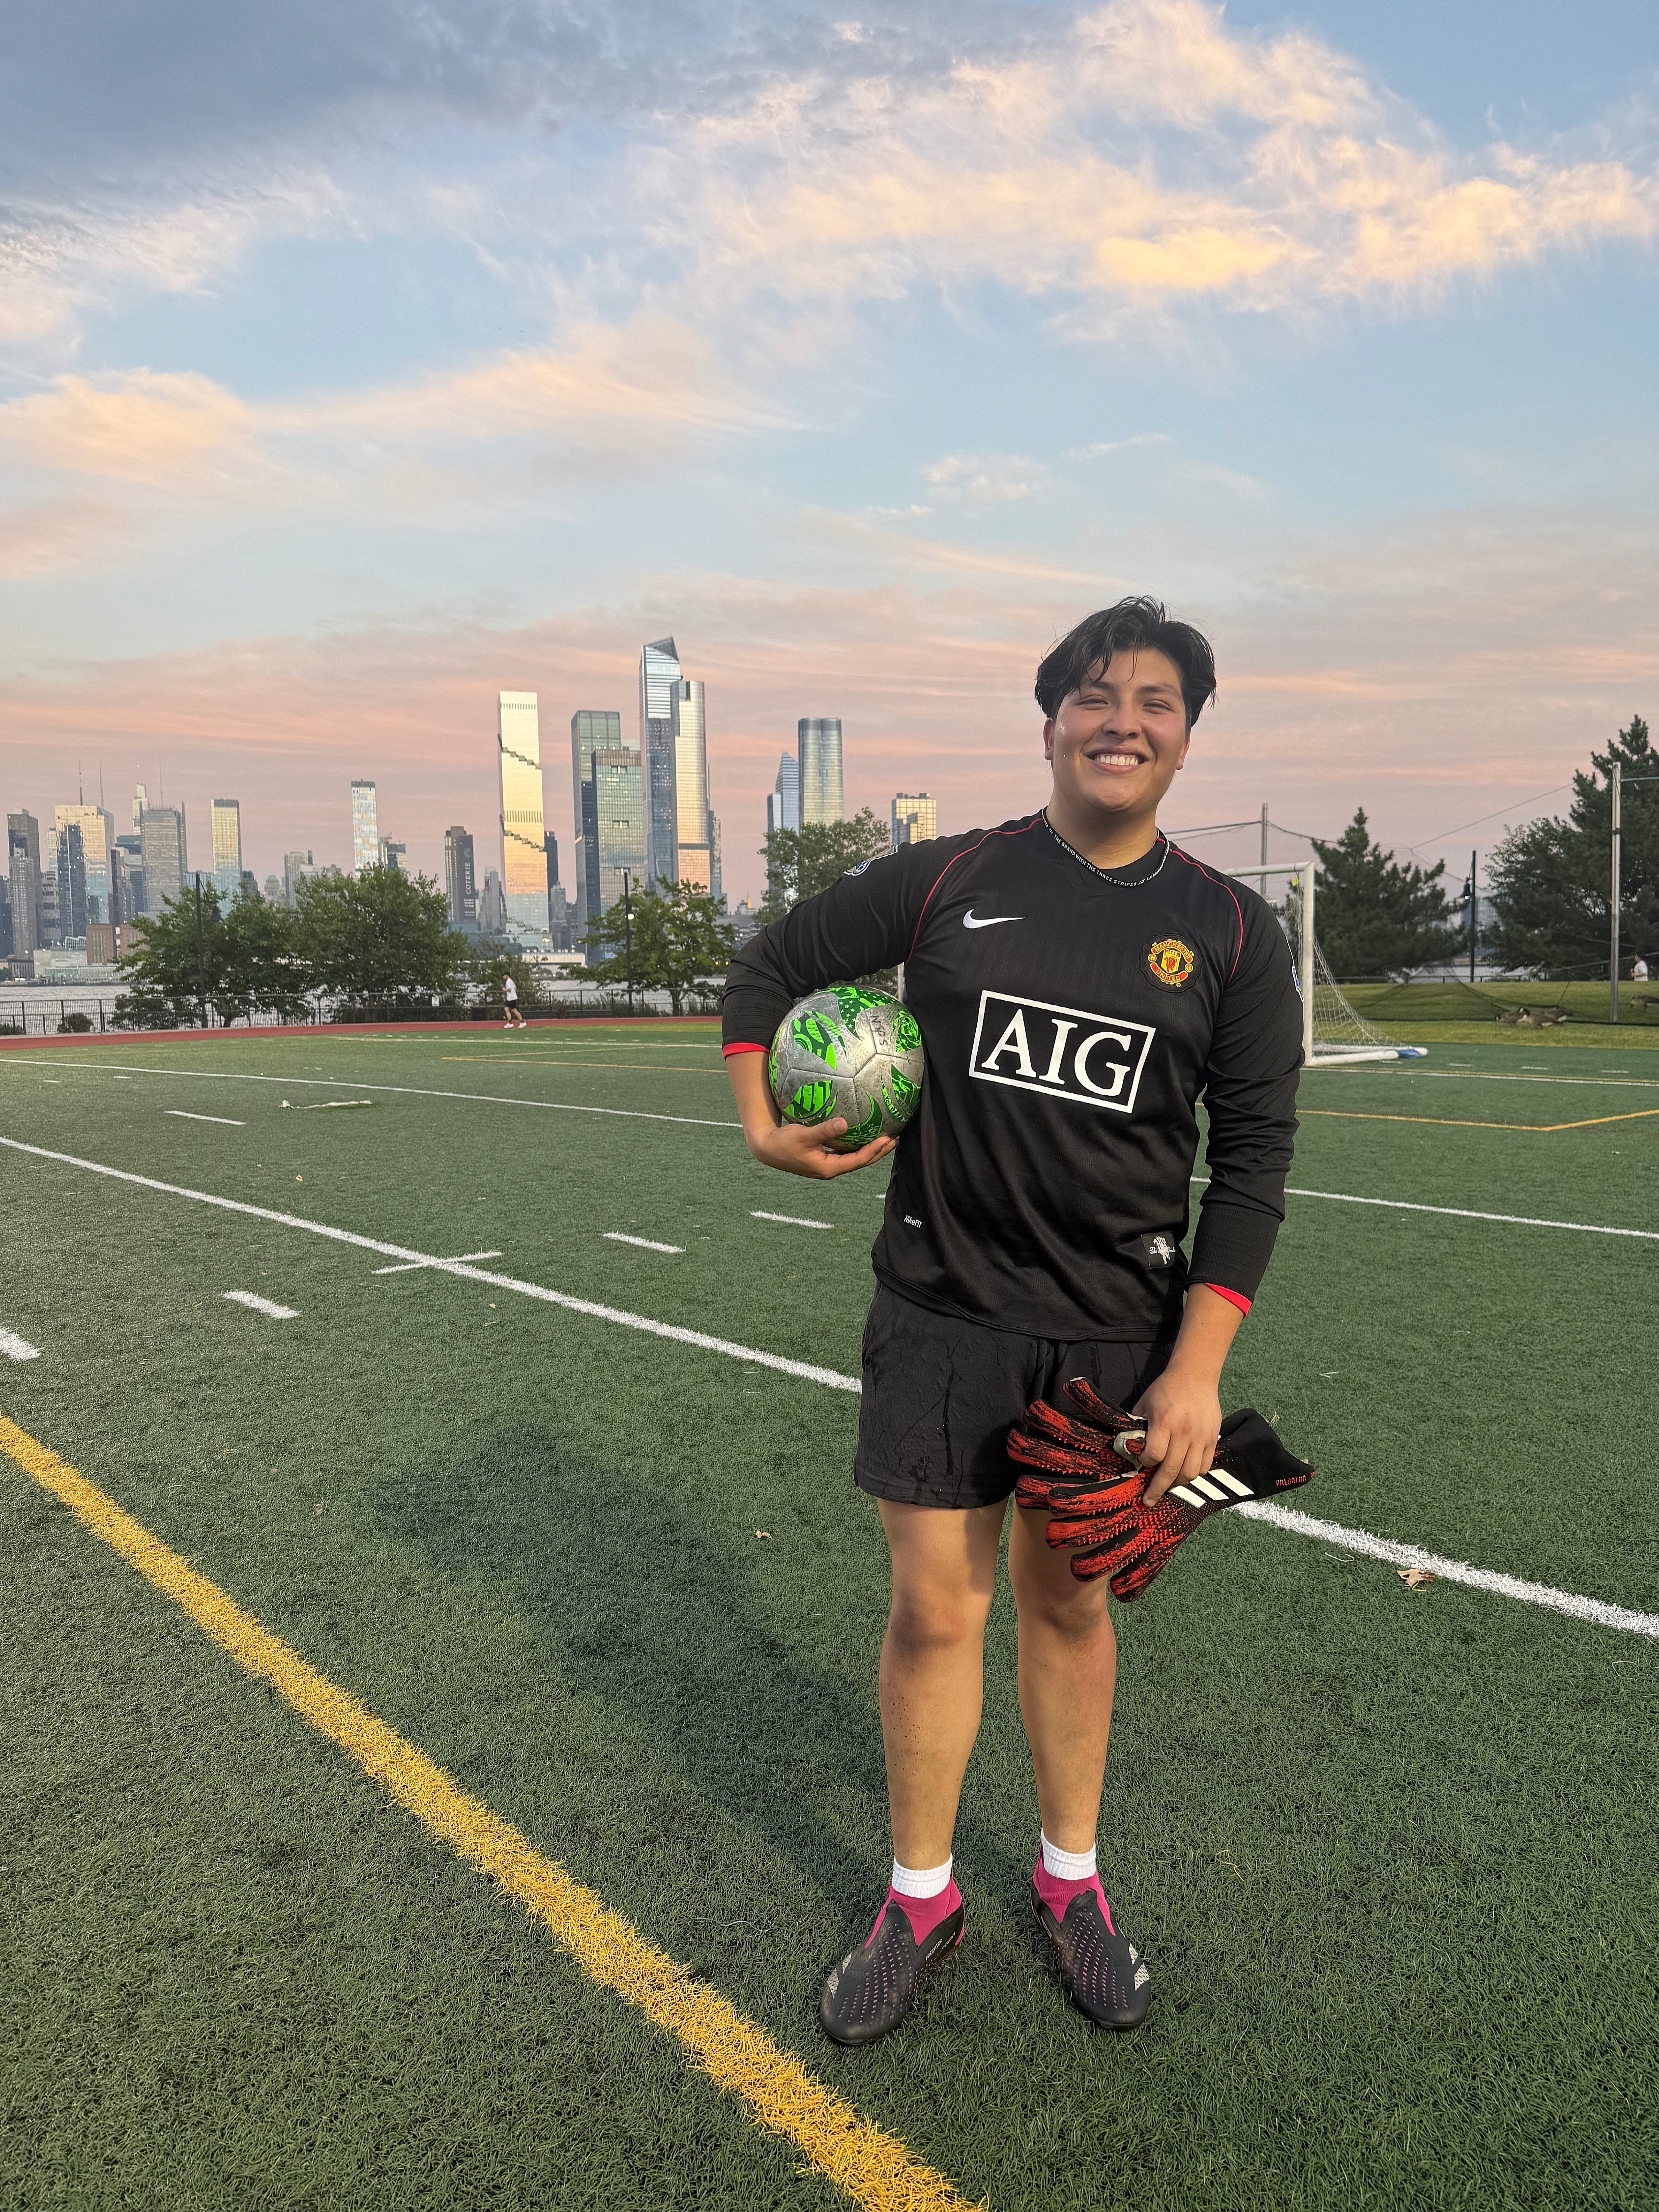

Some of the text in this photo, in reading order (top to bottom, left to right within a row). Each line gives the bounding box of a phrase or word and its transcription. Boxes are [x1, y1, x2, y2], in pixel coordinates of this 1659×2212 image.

[1061, 842, 1076, 856] BRAND
[1075, 853, 1087, 866] WITH
[1087, 862, 1096, 872] THE
[1097, 869, 1113, 882] THREE
[1154, 941, 1191, 960] MANCHESTER
[1156, 969, 1180, 981] UNITED
[981, 1008, 1132, 1096] AIG
[1276, 1475, 1307, 1487] PREDATOR
[925, 1938, 943, 1961] PREDATOR
